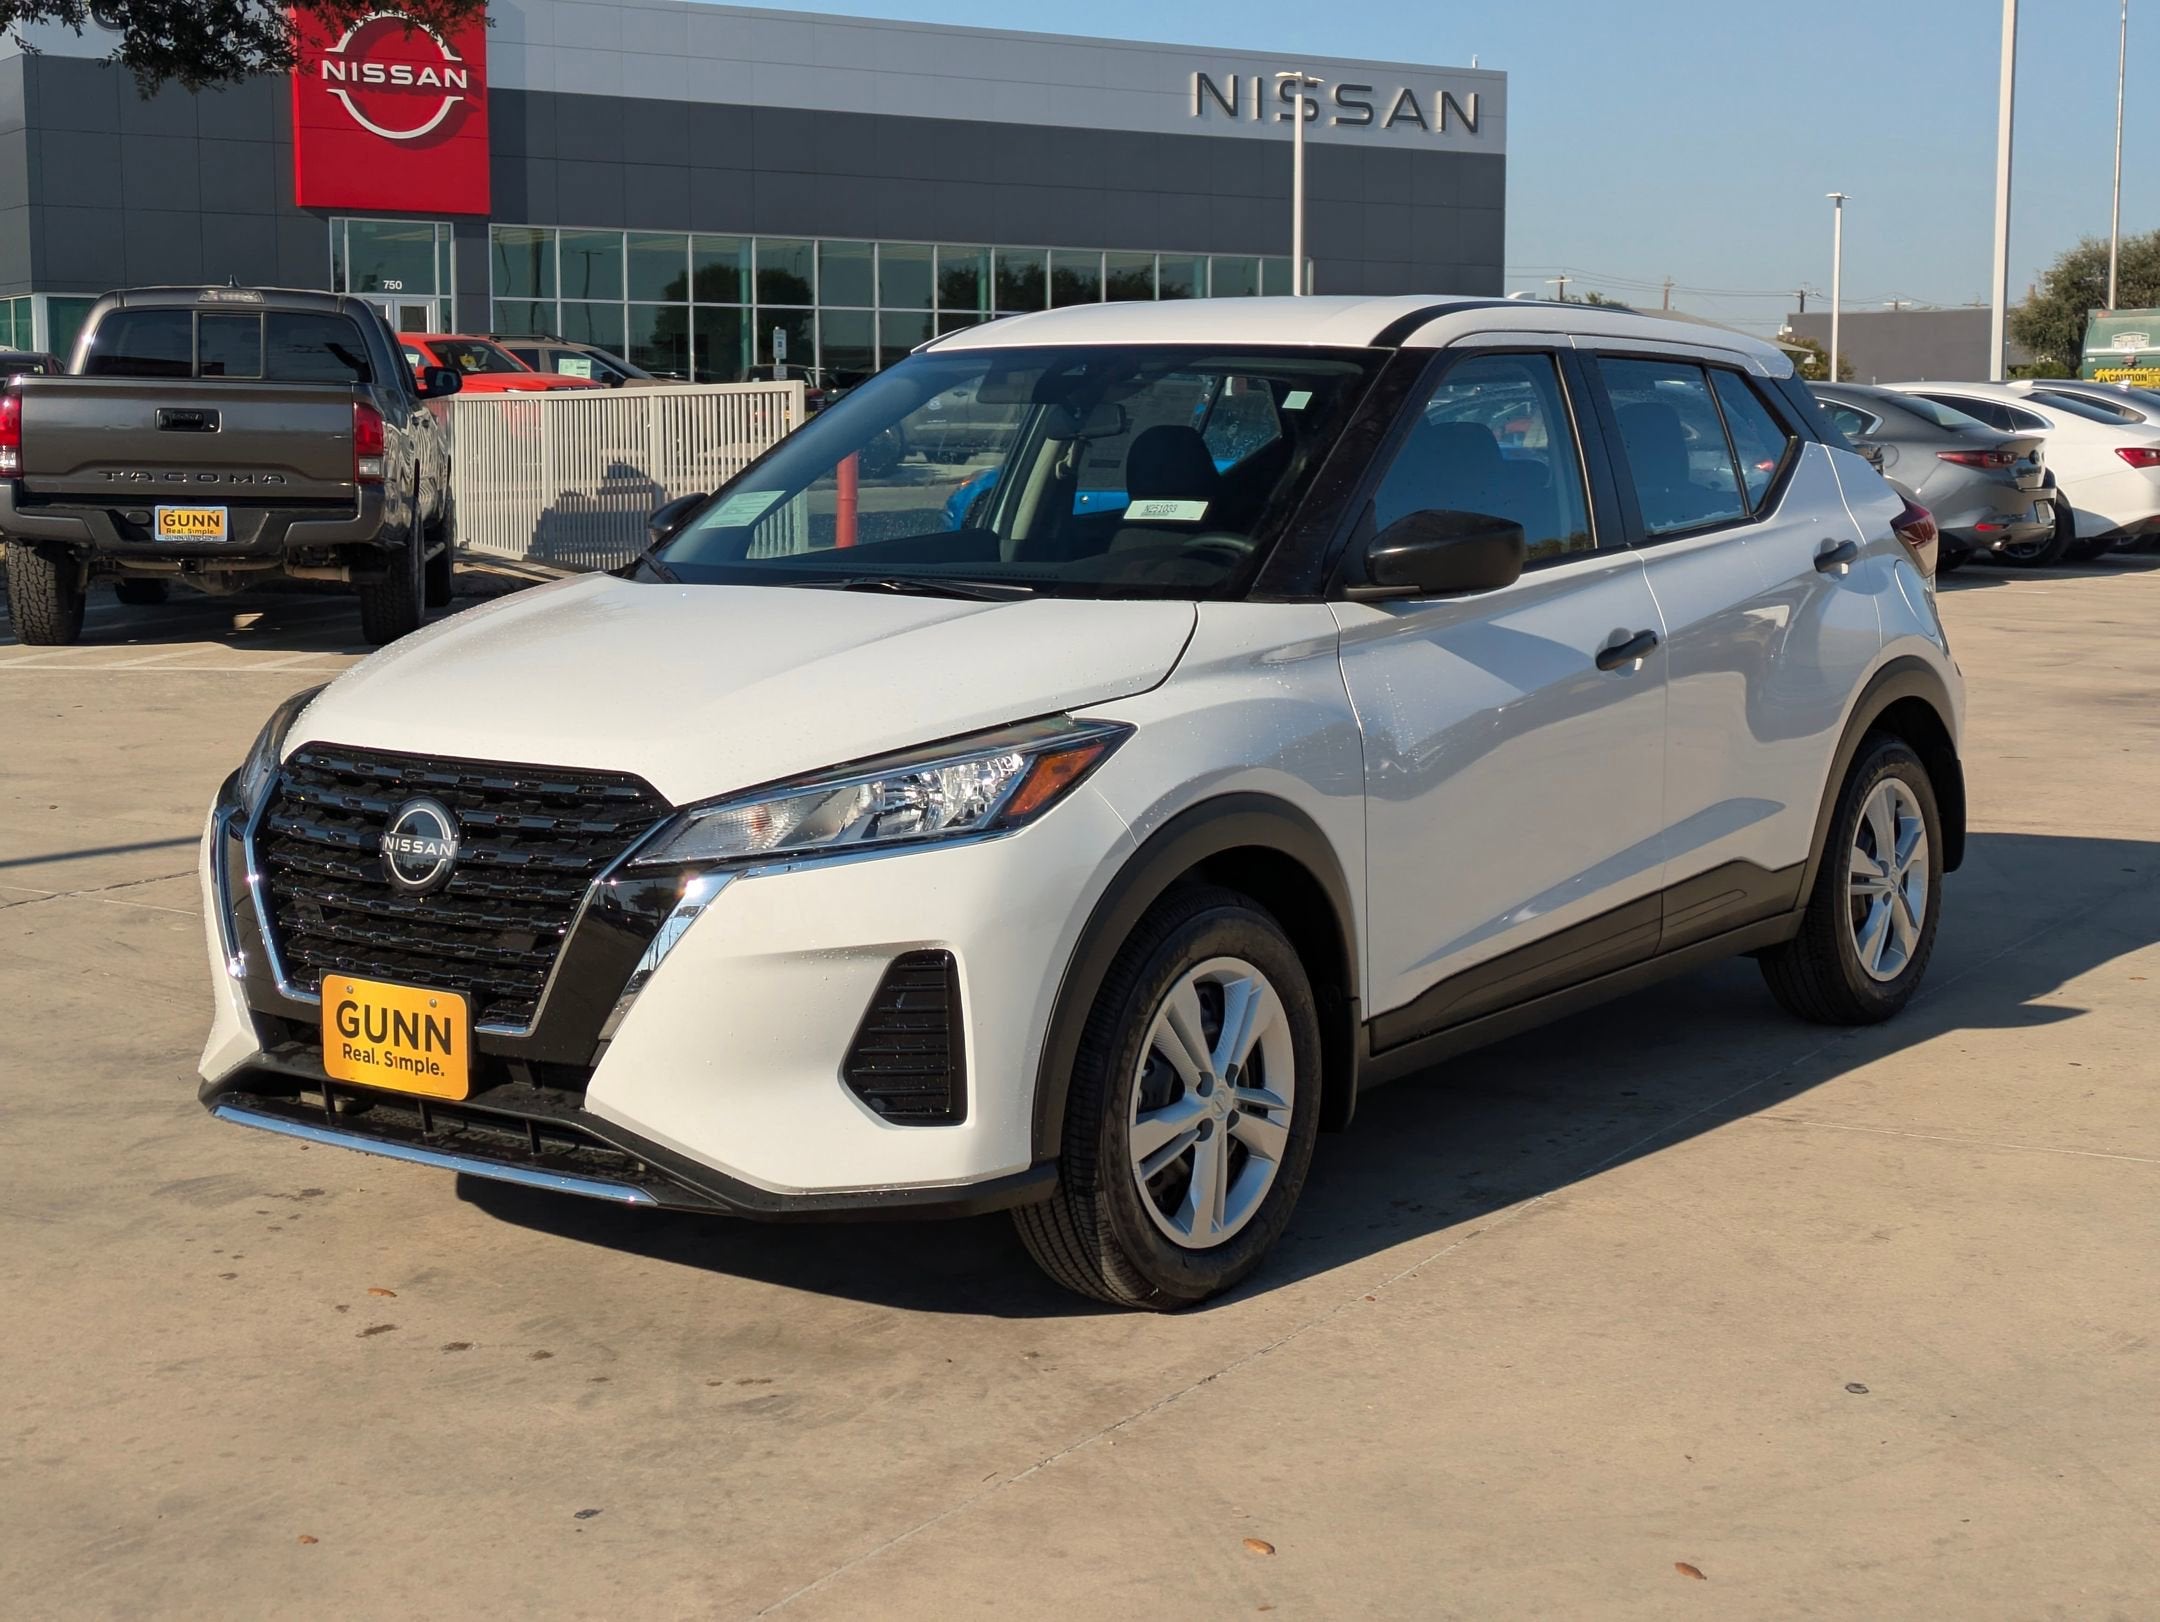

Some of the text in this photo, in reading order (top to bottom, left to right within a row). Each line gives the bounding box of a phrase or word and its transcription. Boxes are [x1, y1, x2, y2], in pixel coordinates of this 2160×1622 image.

[321, 59, 468, 89] NISSAN
[1191, 71, 1480, 134] NISSAN
[383, 280, 403, 290] 750
[2109, 373, 2148, 382] CAUTION
[98, 471, 288, 485] TACOMA
[163, 514, 220, 527] GUNN
[166, 527, 186, 535] Real.
[384, 835, 454, 857] NISSAN
[335, 1000, 452, 1056] GUNN
[342, 1043, 380, 1066] Real.
